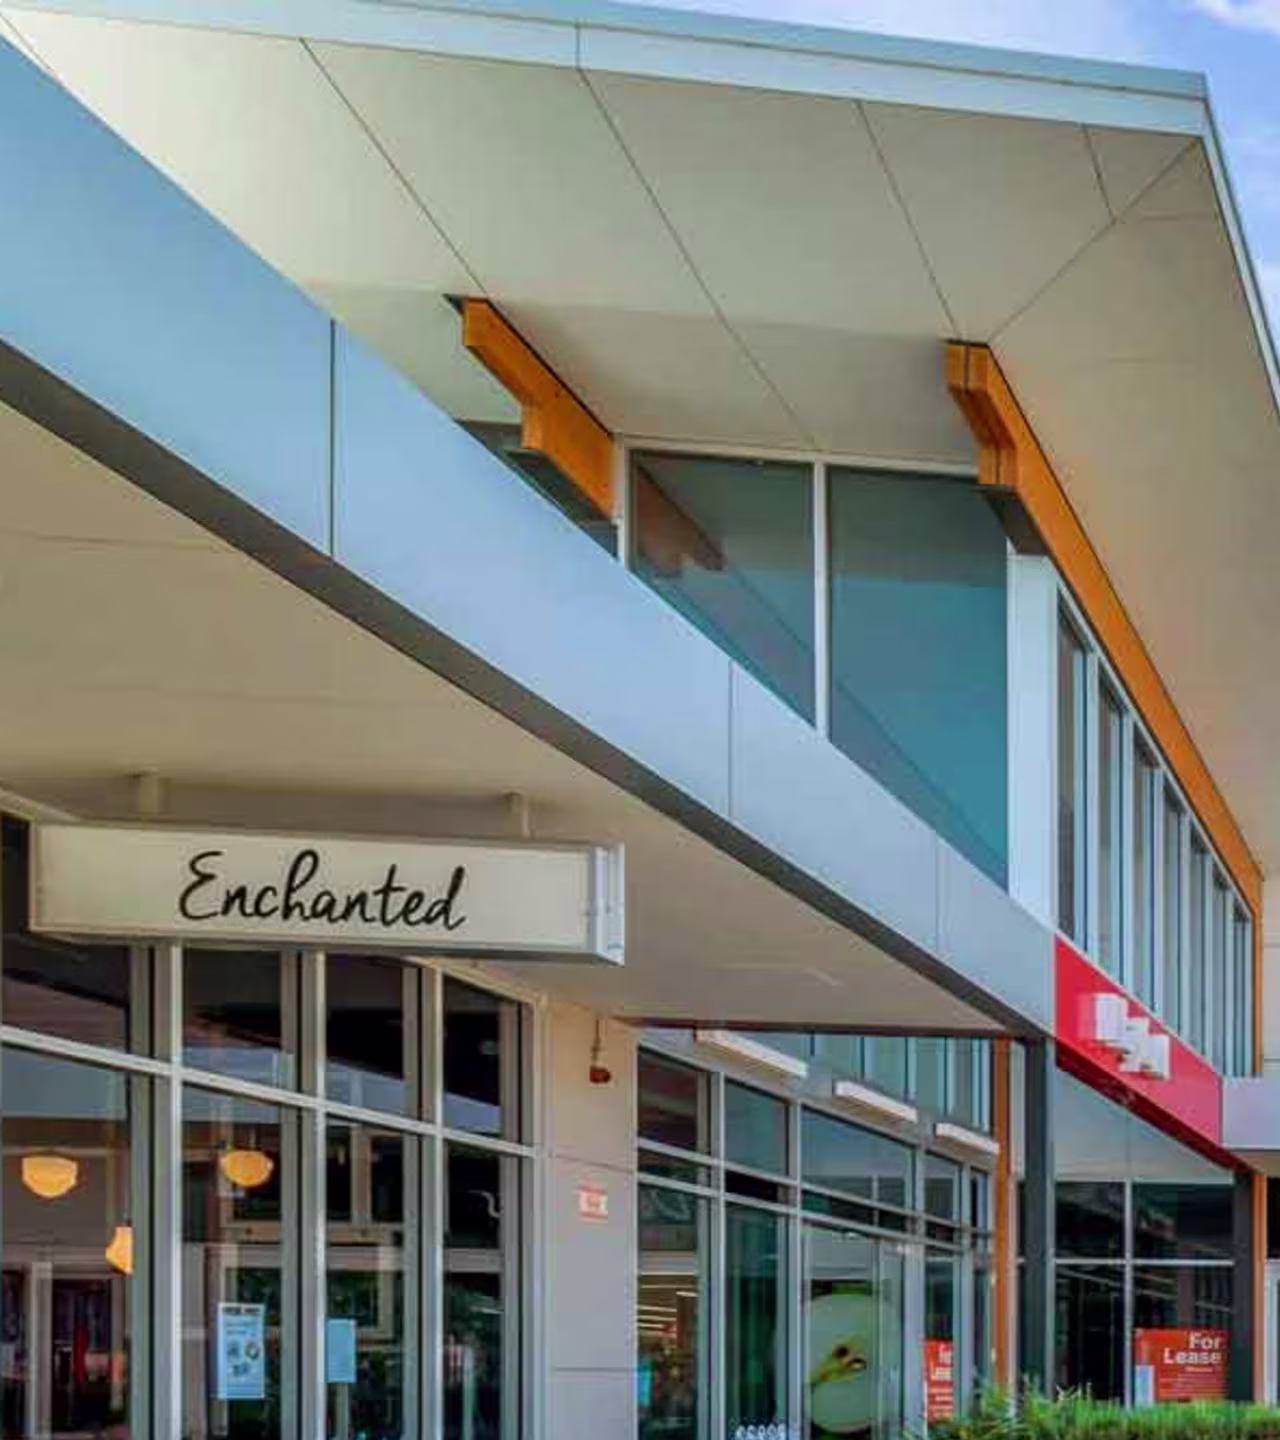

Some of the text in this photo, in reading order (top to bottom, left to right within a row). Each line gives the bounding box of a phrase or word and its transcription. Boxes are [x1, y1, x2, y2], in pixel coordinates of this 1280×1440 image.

[179, 848, 466, 931] Enchanted
[1189, 1331, 1222, 1349] For
[1163, 1347, 1222, 1364] Lease
